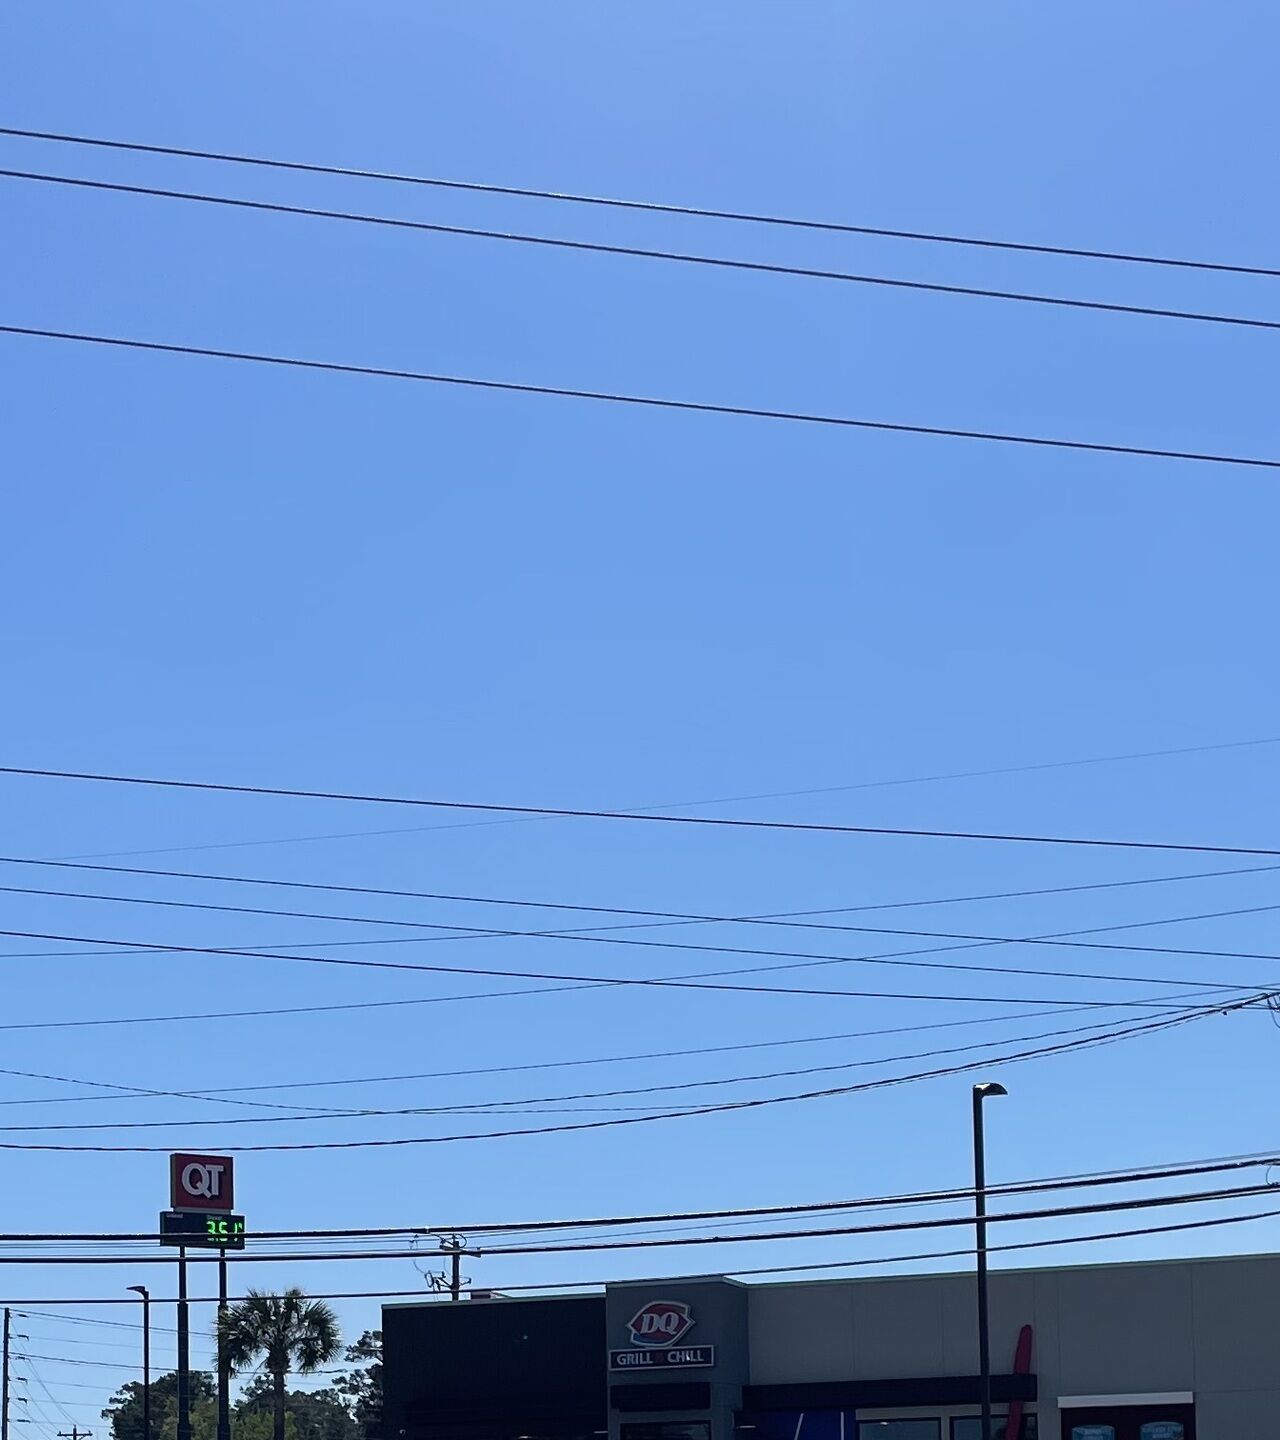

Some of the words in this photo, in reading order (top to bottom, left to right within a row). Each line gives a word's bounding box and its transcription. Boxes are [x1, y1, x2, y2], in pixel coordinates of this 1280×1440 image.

[181, 1162, 224, 1198] QT
[640, 1312, 679, 1334] DQ
[616, 1353, 654, 1365] GRILL
[667, 1350, 705, 1363] CHILL
